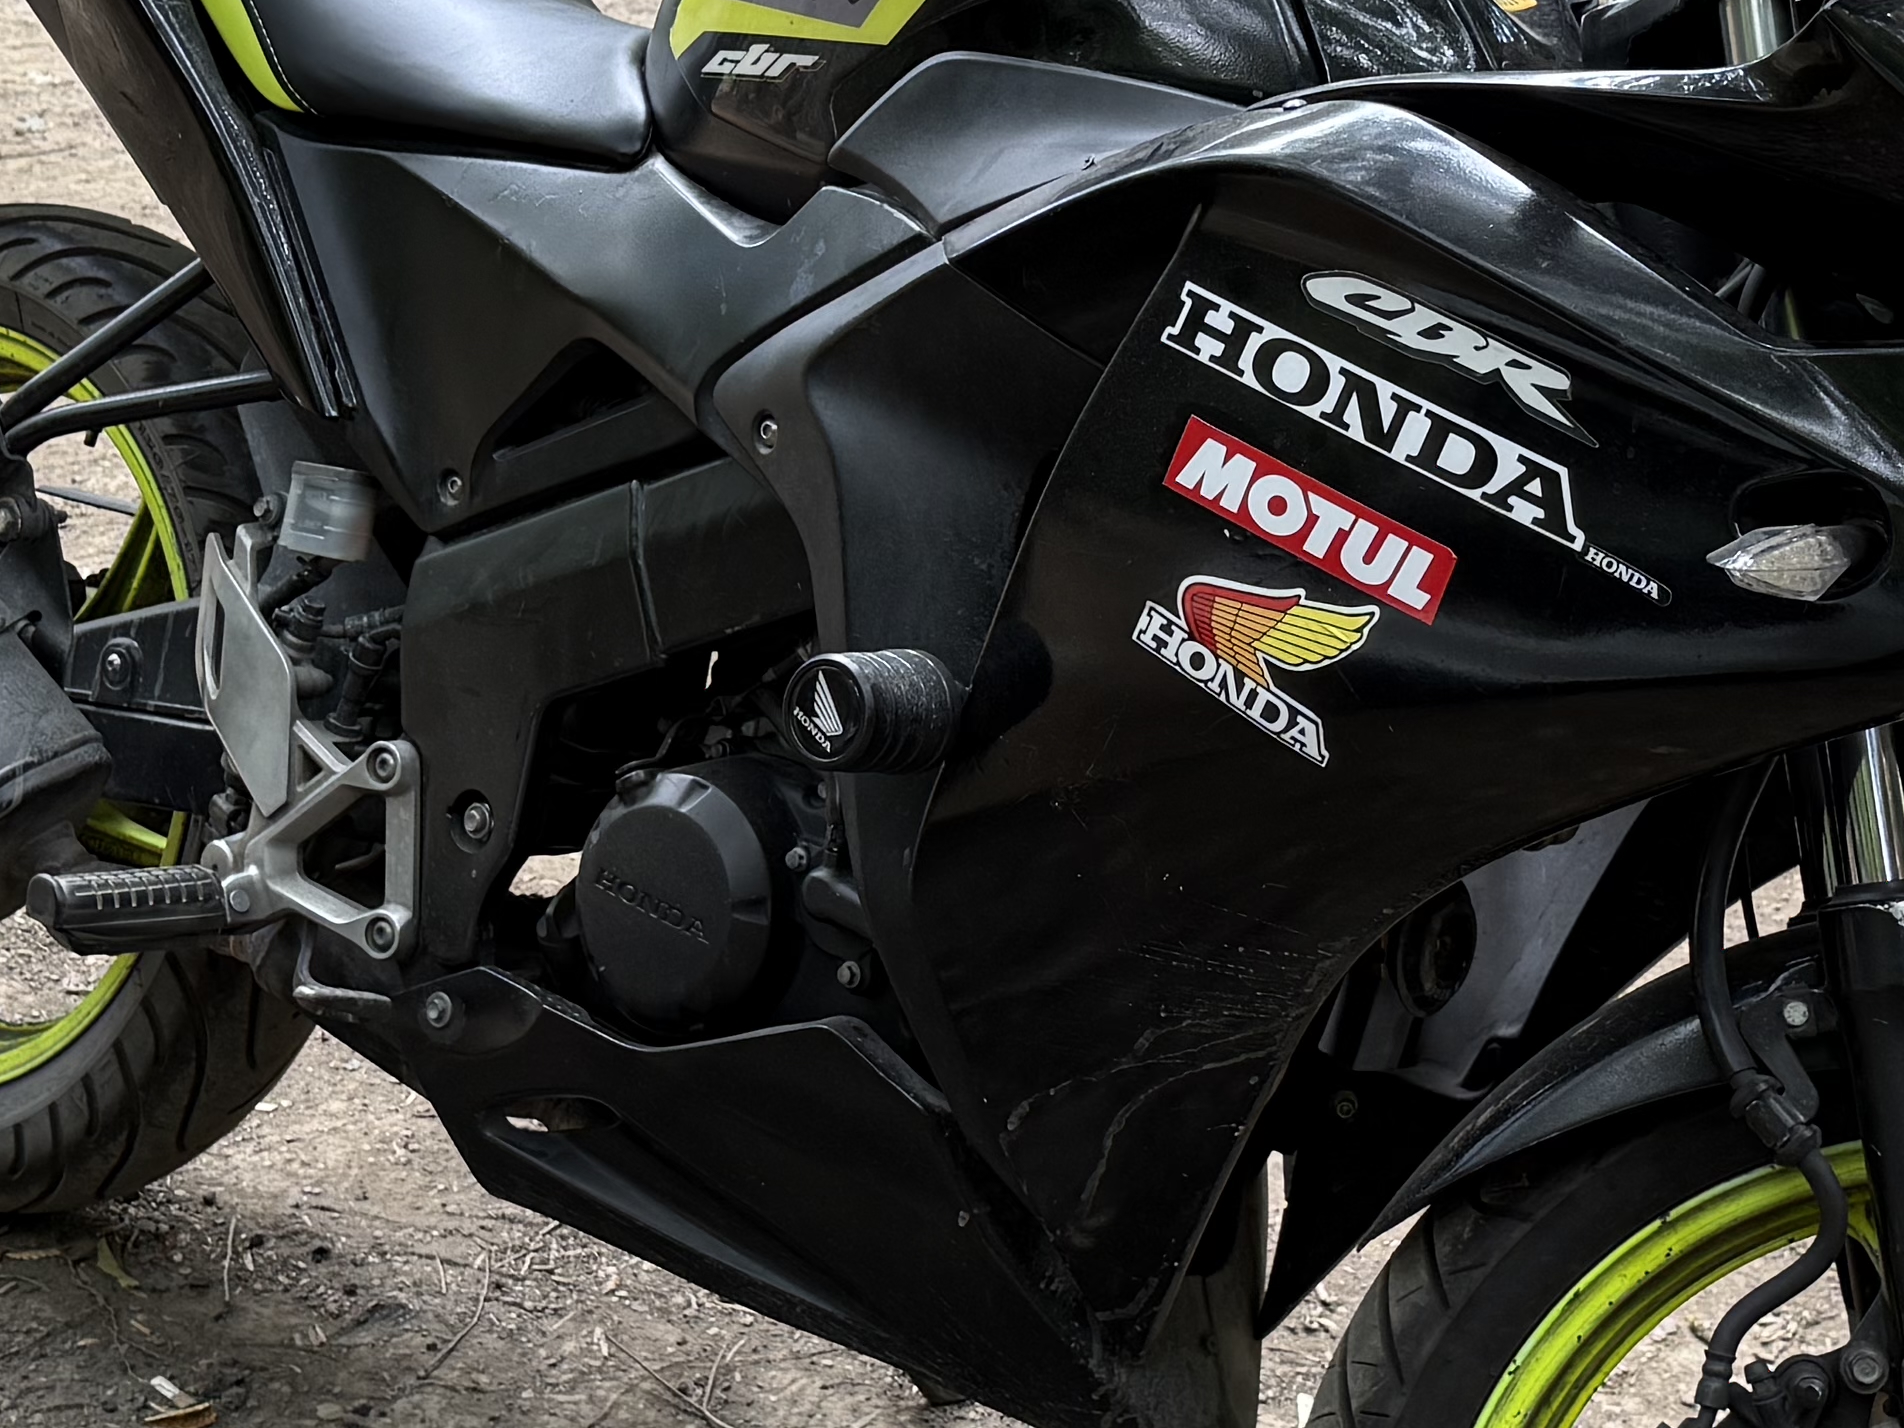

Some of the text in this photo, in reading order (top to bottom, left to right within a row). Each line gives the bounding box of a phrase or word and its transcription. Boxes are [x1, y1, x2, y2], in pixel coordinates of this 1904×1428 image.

[1164, 284, 1581, 547] HONDA
[1302, 272, 1592, 442] CBR
[1174, 437, 1440, 612] MOTUL
[1583, 547, 1659, 600] HONDA
[793, 705, 831, 753] HONDA
[1139, 609, 1323, 762] HONDA
[595, 868, 709, 944] HONDA
